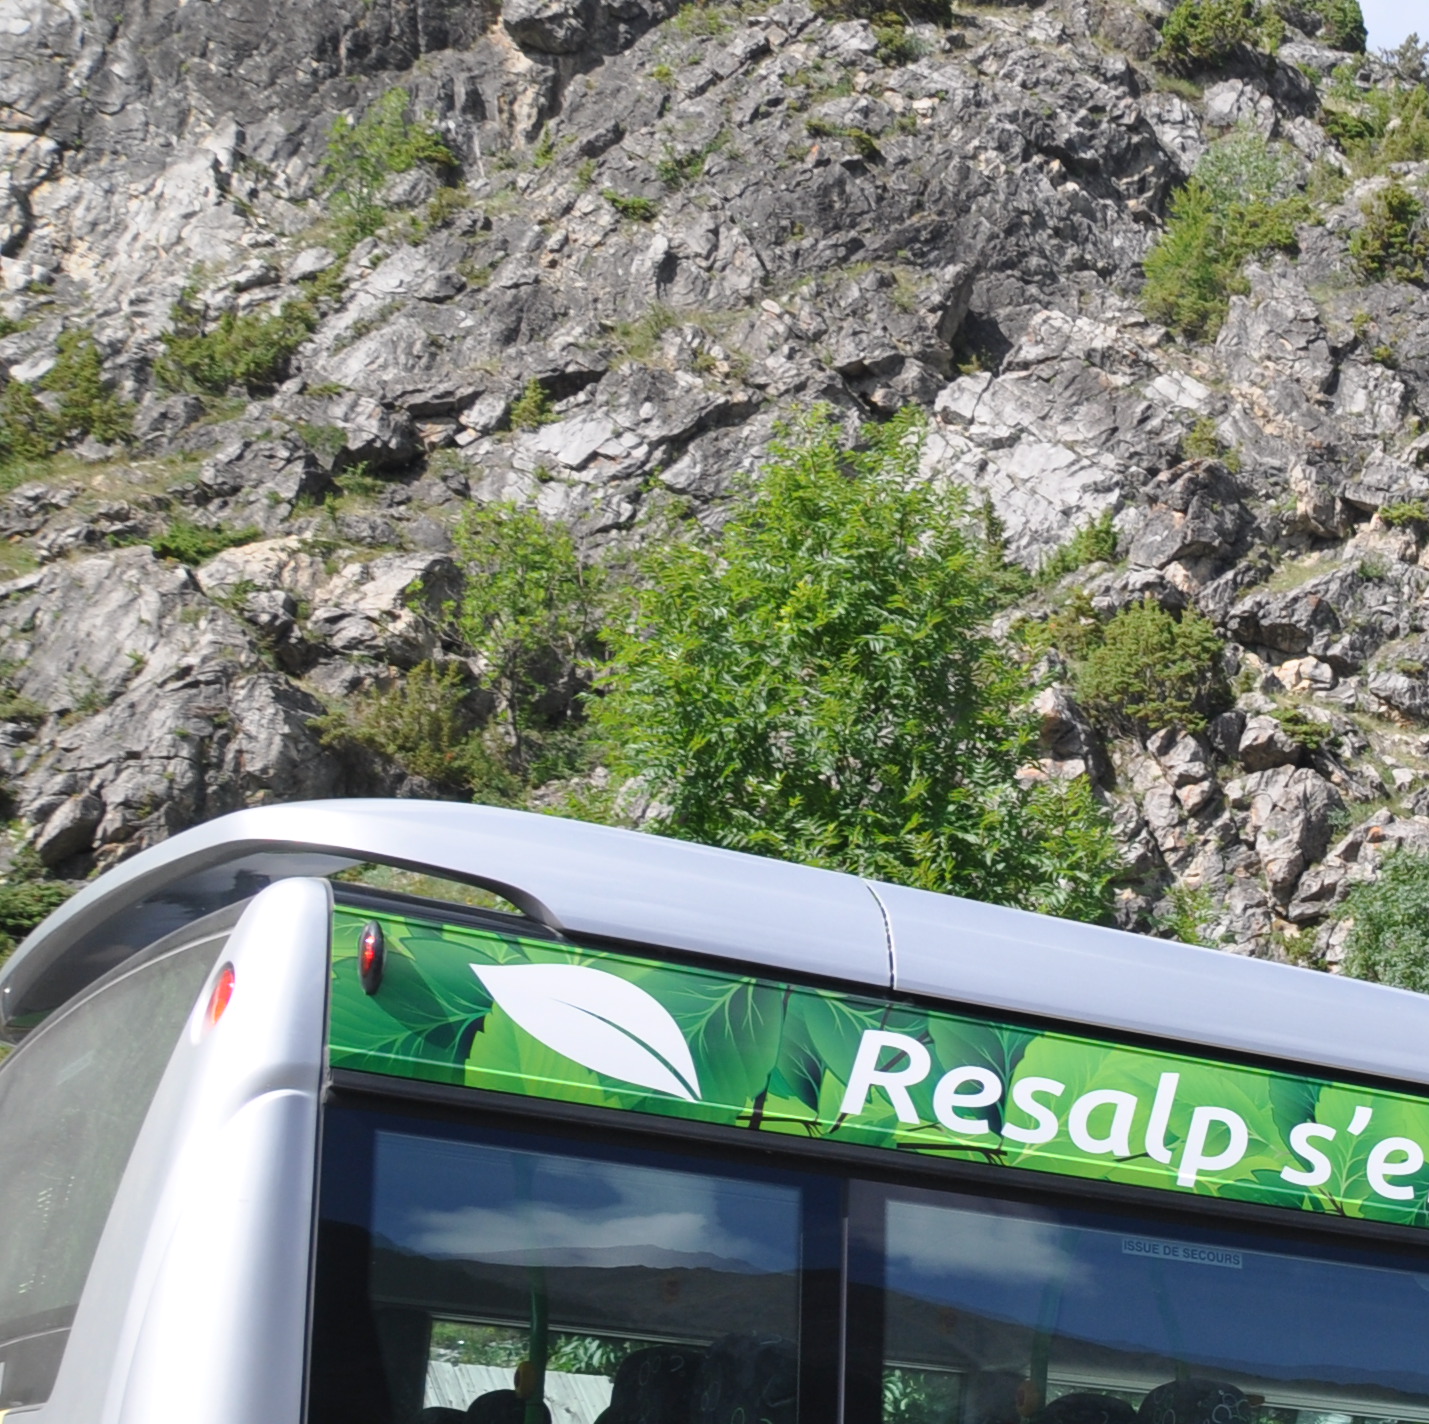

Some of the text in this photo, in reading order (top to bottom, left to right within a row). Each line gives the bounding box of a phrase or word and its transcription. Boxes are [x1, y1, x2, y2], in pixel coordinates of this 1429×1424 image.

[839, 1029, 1249, 1188] Resalp
[1124, 1240, 1240, 1266] ISSUE DE SECOURS
